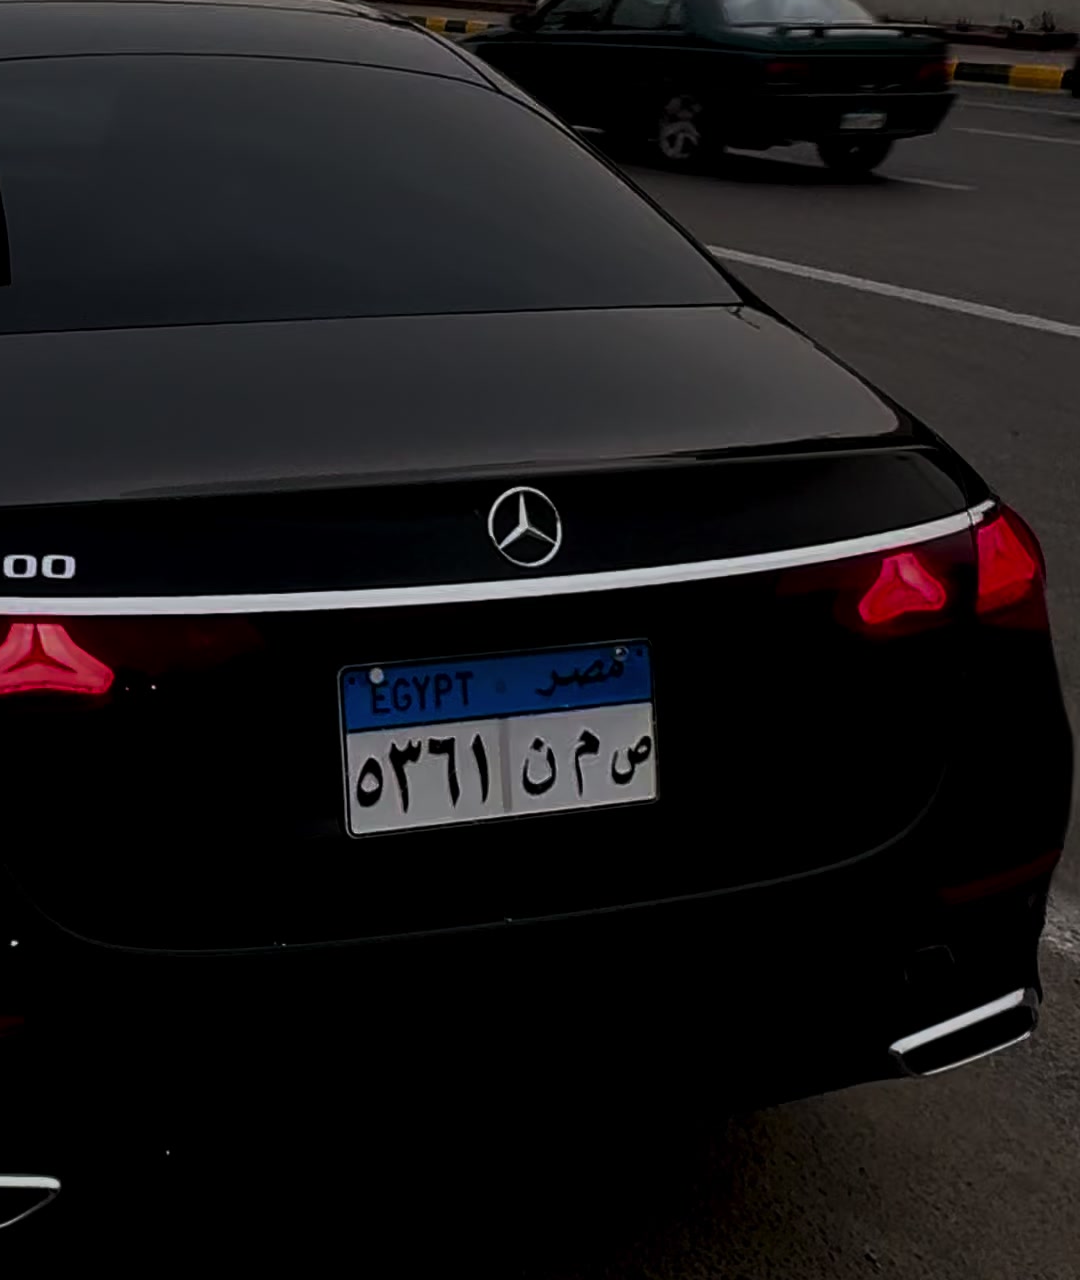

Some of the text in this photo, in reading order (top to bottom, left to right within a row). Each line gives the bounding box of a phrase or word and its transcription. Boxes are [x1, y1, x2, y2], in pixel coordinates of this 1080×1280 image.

[371, 671, 473, 714] EGYPT
[536, 658, 625, 697] مصر
[356, 732, 490, 814] ٥٣٦١
